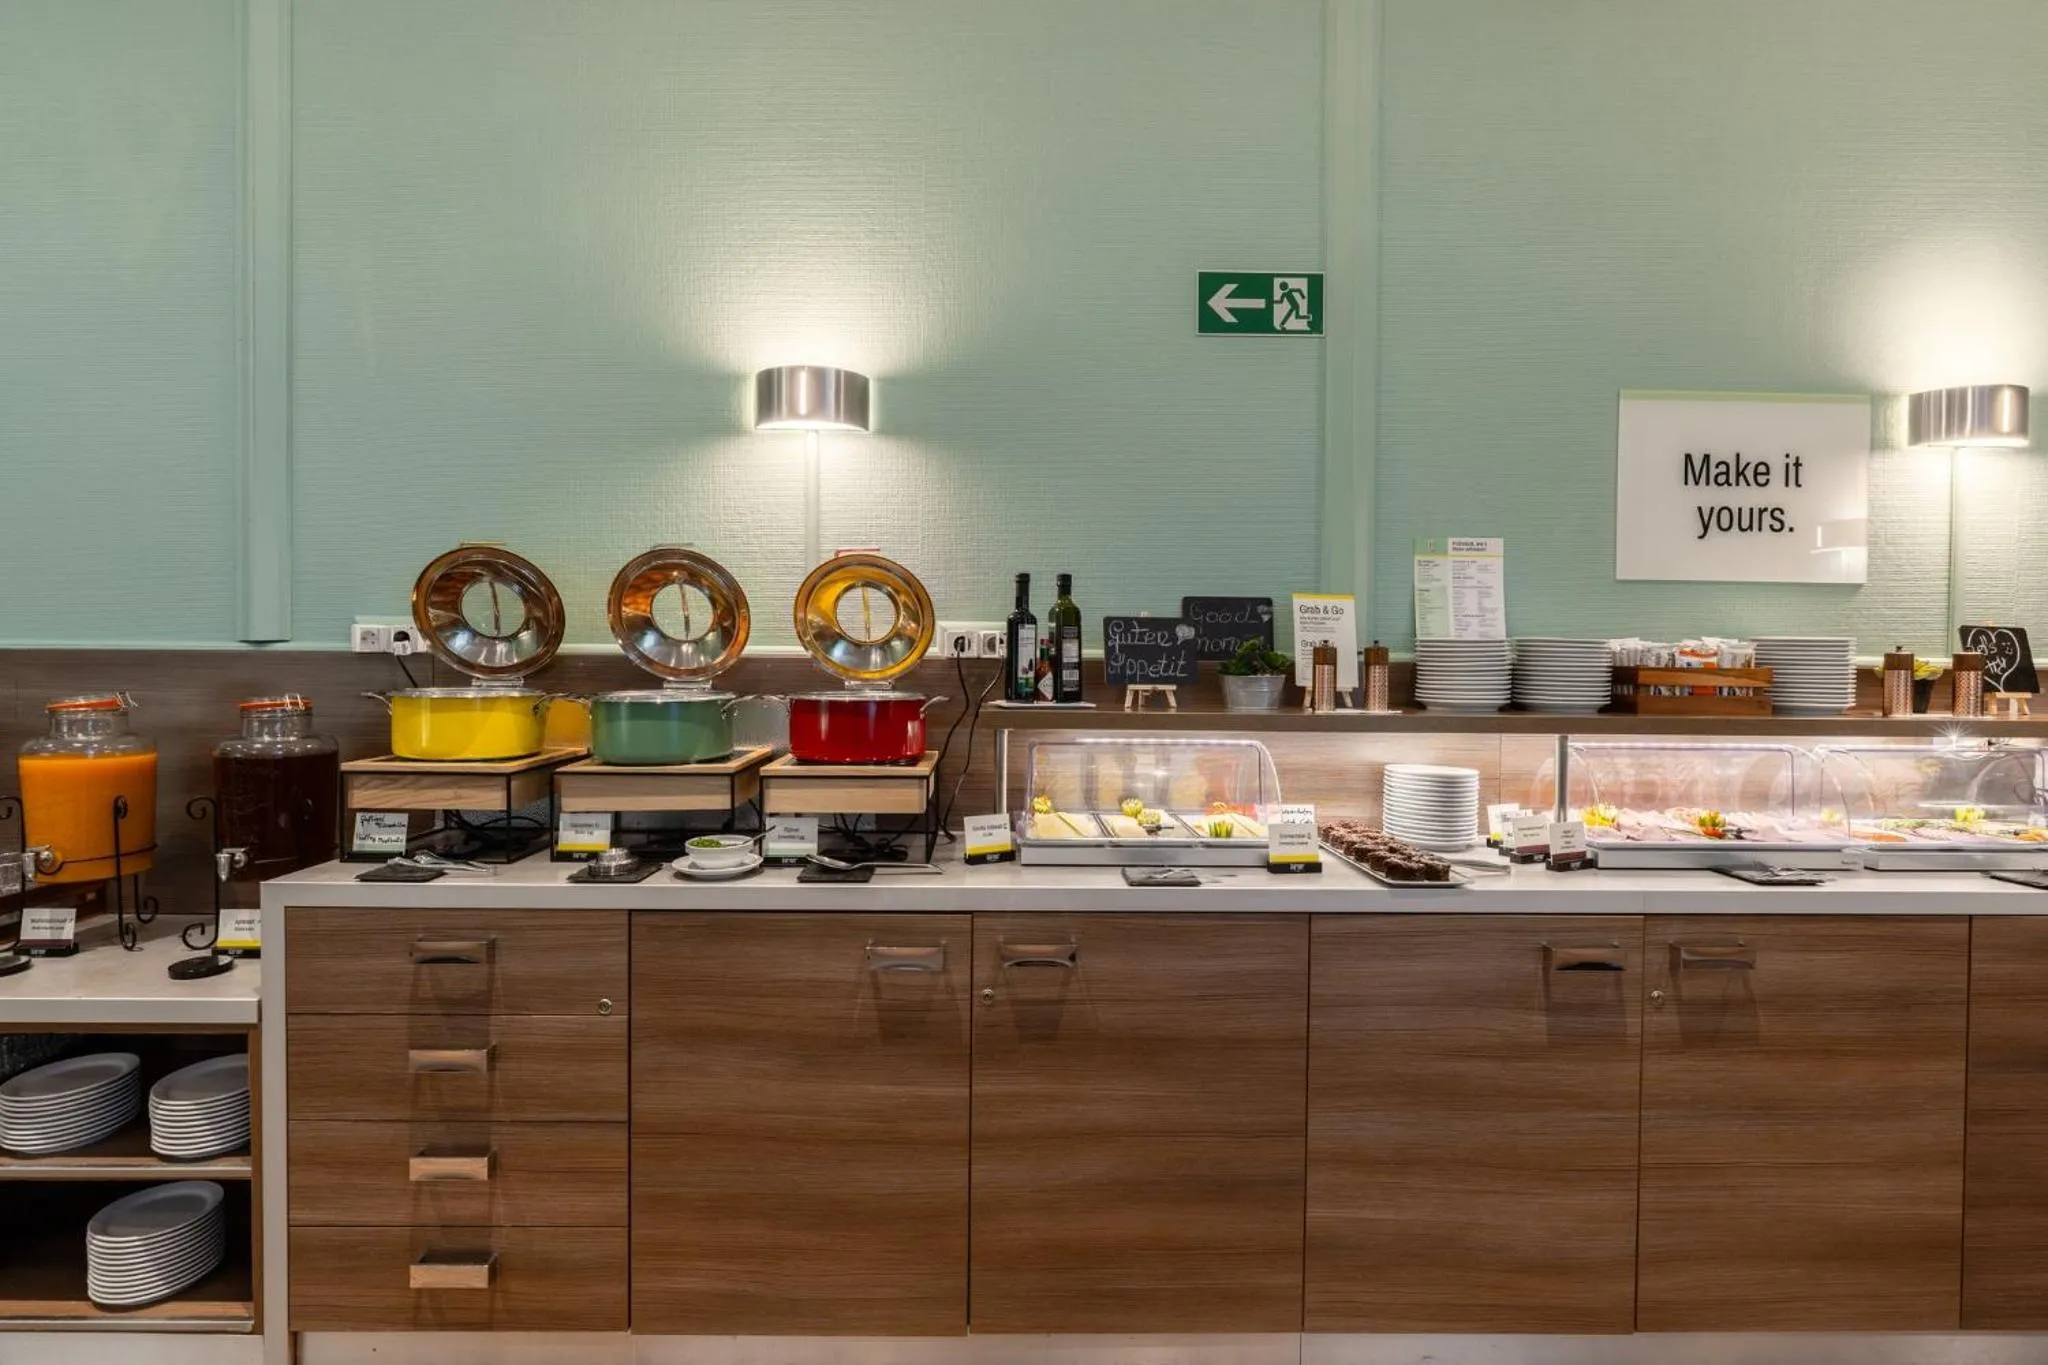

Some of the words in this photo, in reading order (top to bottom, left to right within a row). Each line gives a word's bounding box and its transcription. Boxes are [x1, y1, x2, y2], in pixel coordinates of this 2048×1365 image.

[1684, 452, 1770, 487] Make
[1784, 452, 1803, 488] it
[1697, 506, 1794, 539] yours.
[1190, 602, 1258, 628] Good
[1300, 604, 1321, 614] Grab
[1322, 605, 1330, 615] &
[1331, 605, 1345, 615] Go
